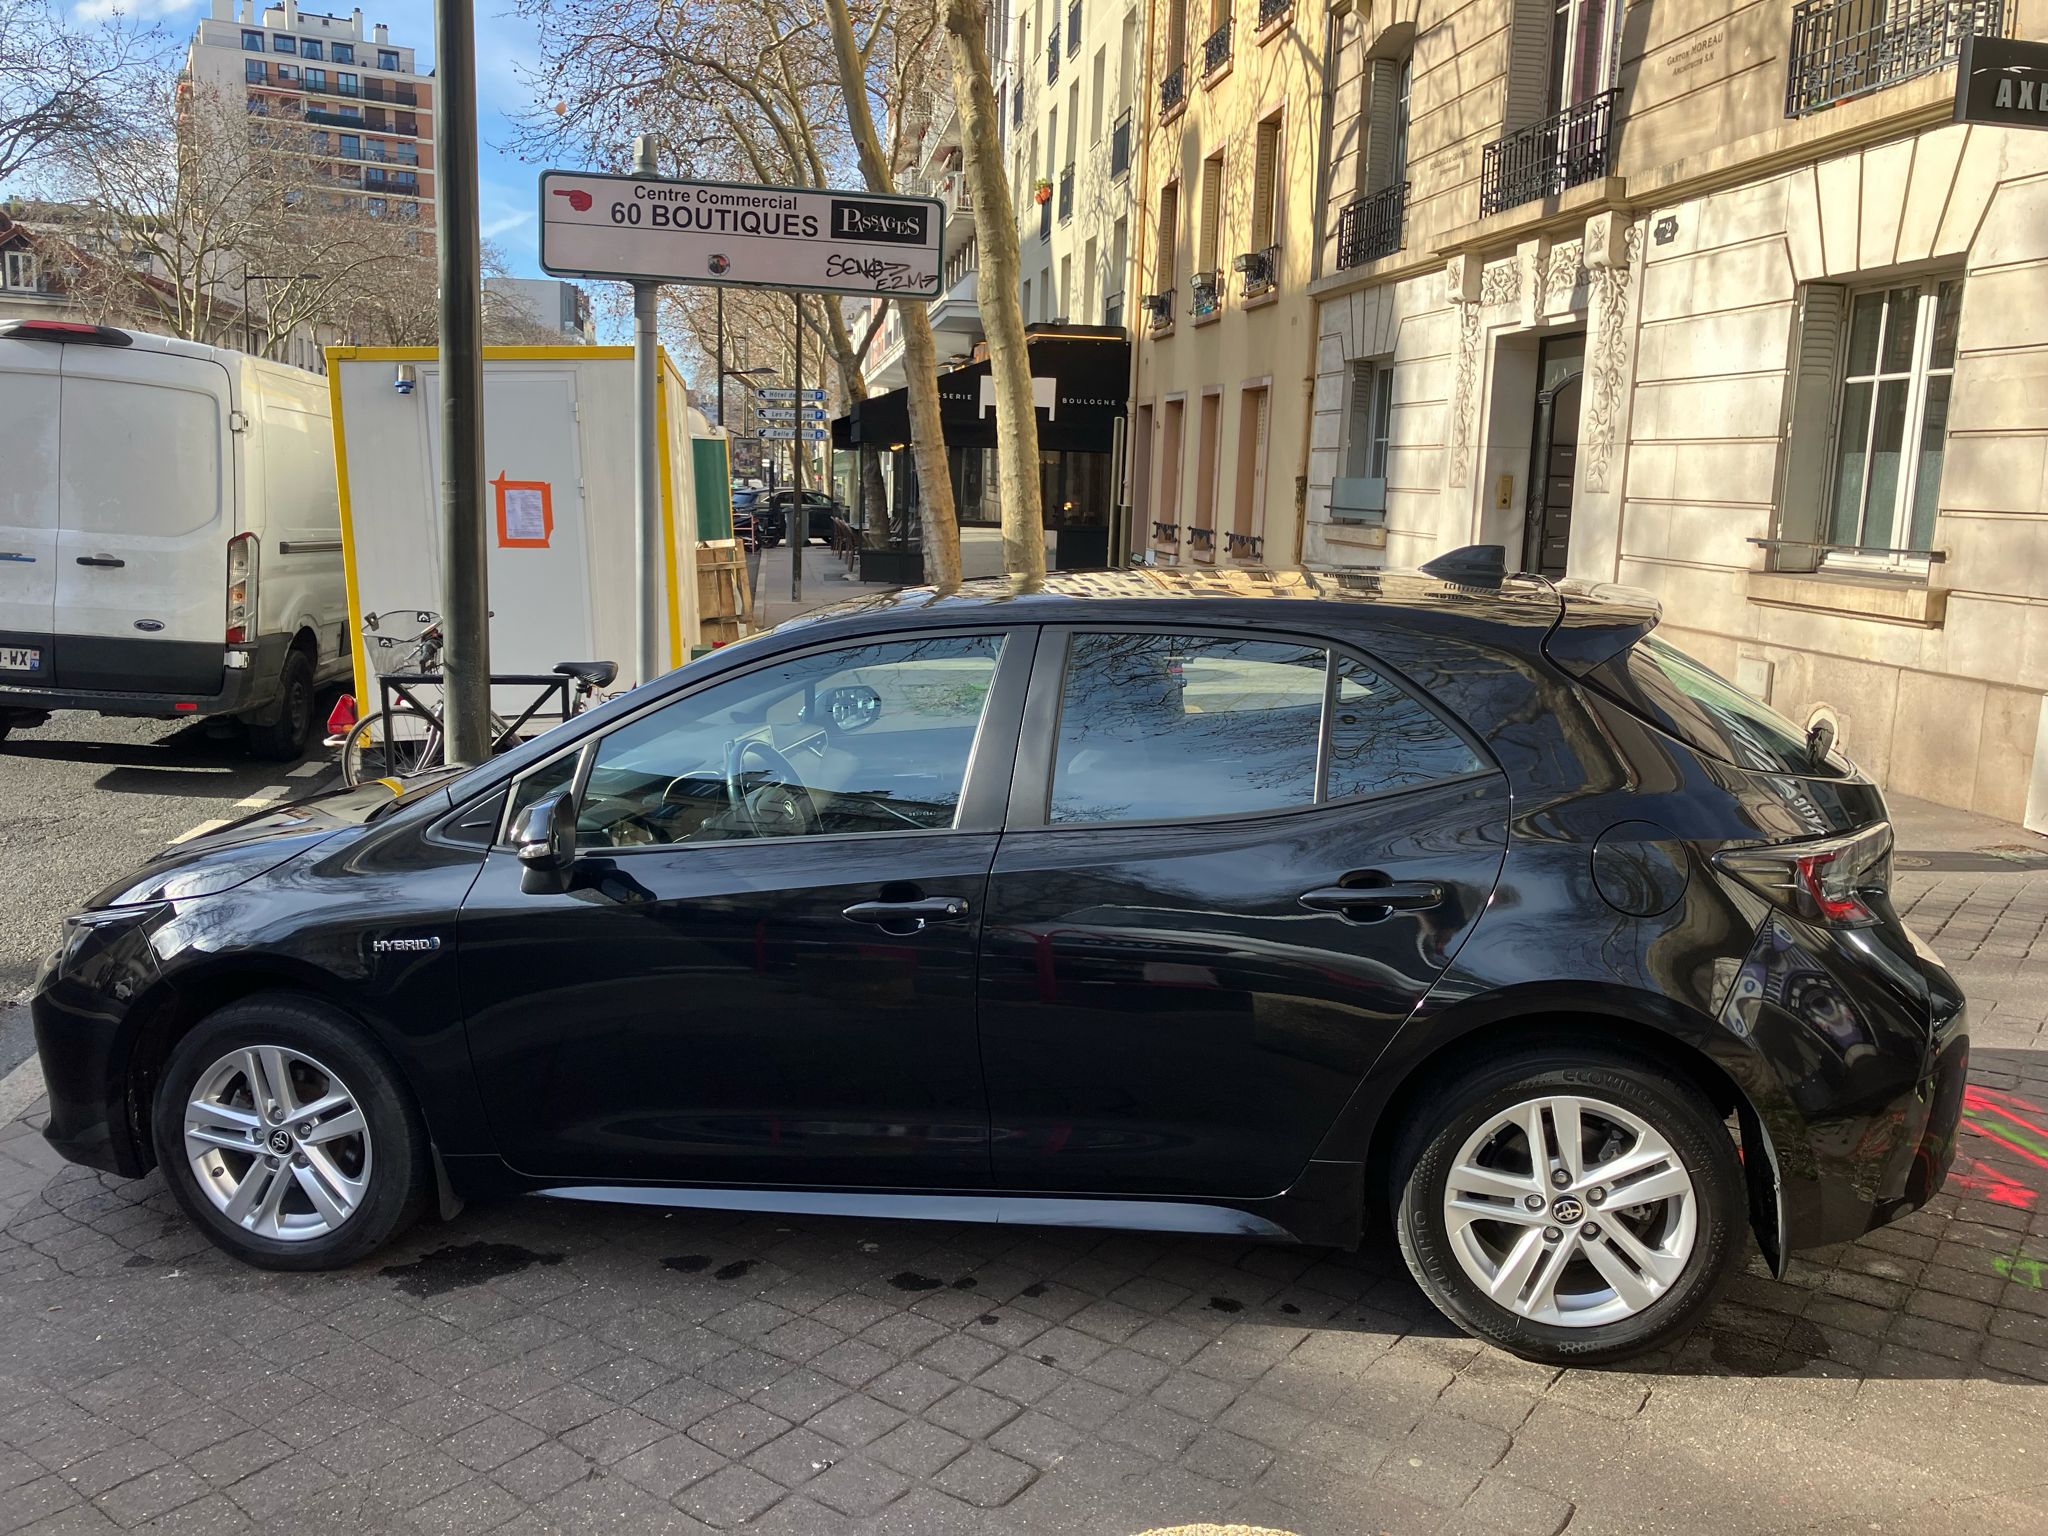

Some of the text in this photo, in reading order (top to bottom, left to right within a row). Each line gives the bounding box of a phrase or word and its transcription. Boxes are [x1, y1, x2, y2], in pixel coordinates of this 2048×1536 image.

[634, 185, 798, 210] Centre Commercial
[611, 202, 819, 238] 60 BOUTIQUES
[1062, 397, 1116, 406] BOULOGNE
[0, 649, 28, 666] -WX
[373, 939, 430, 952] HYBRID
